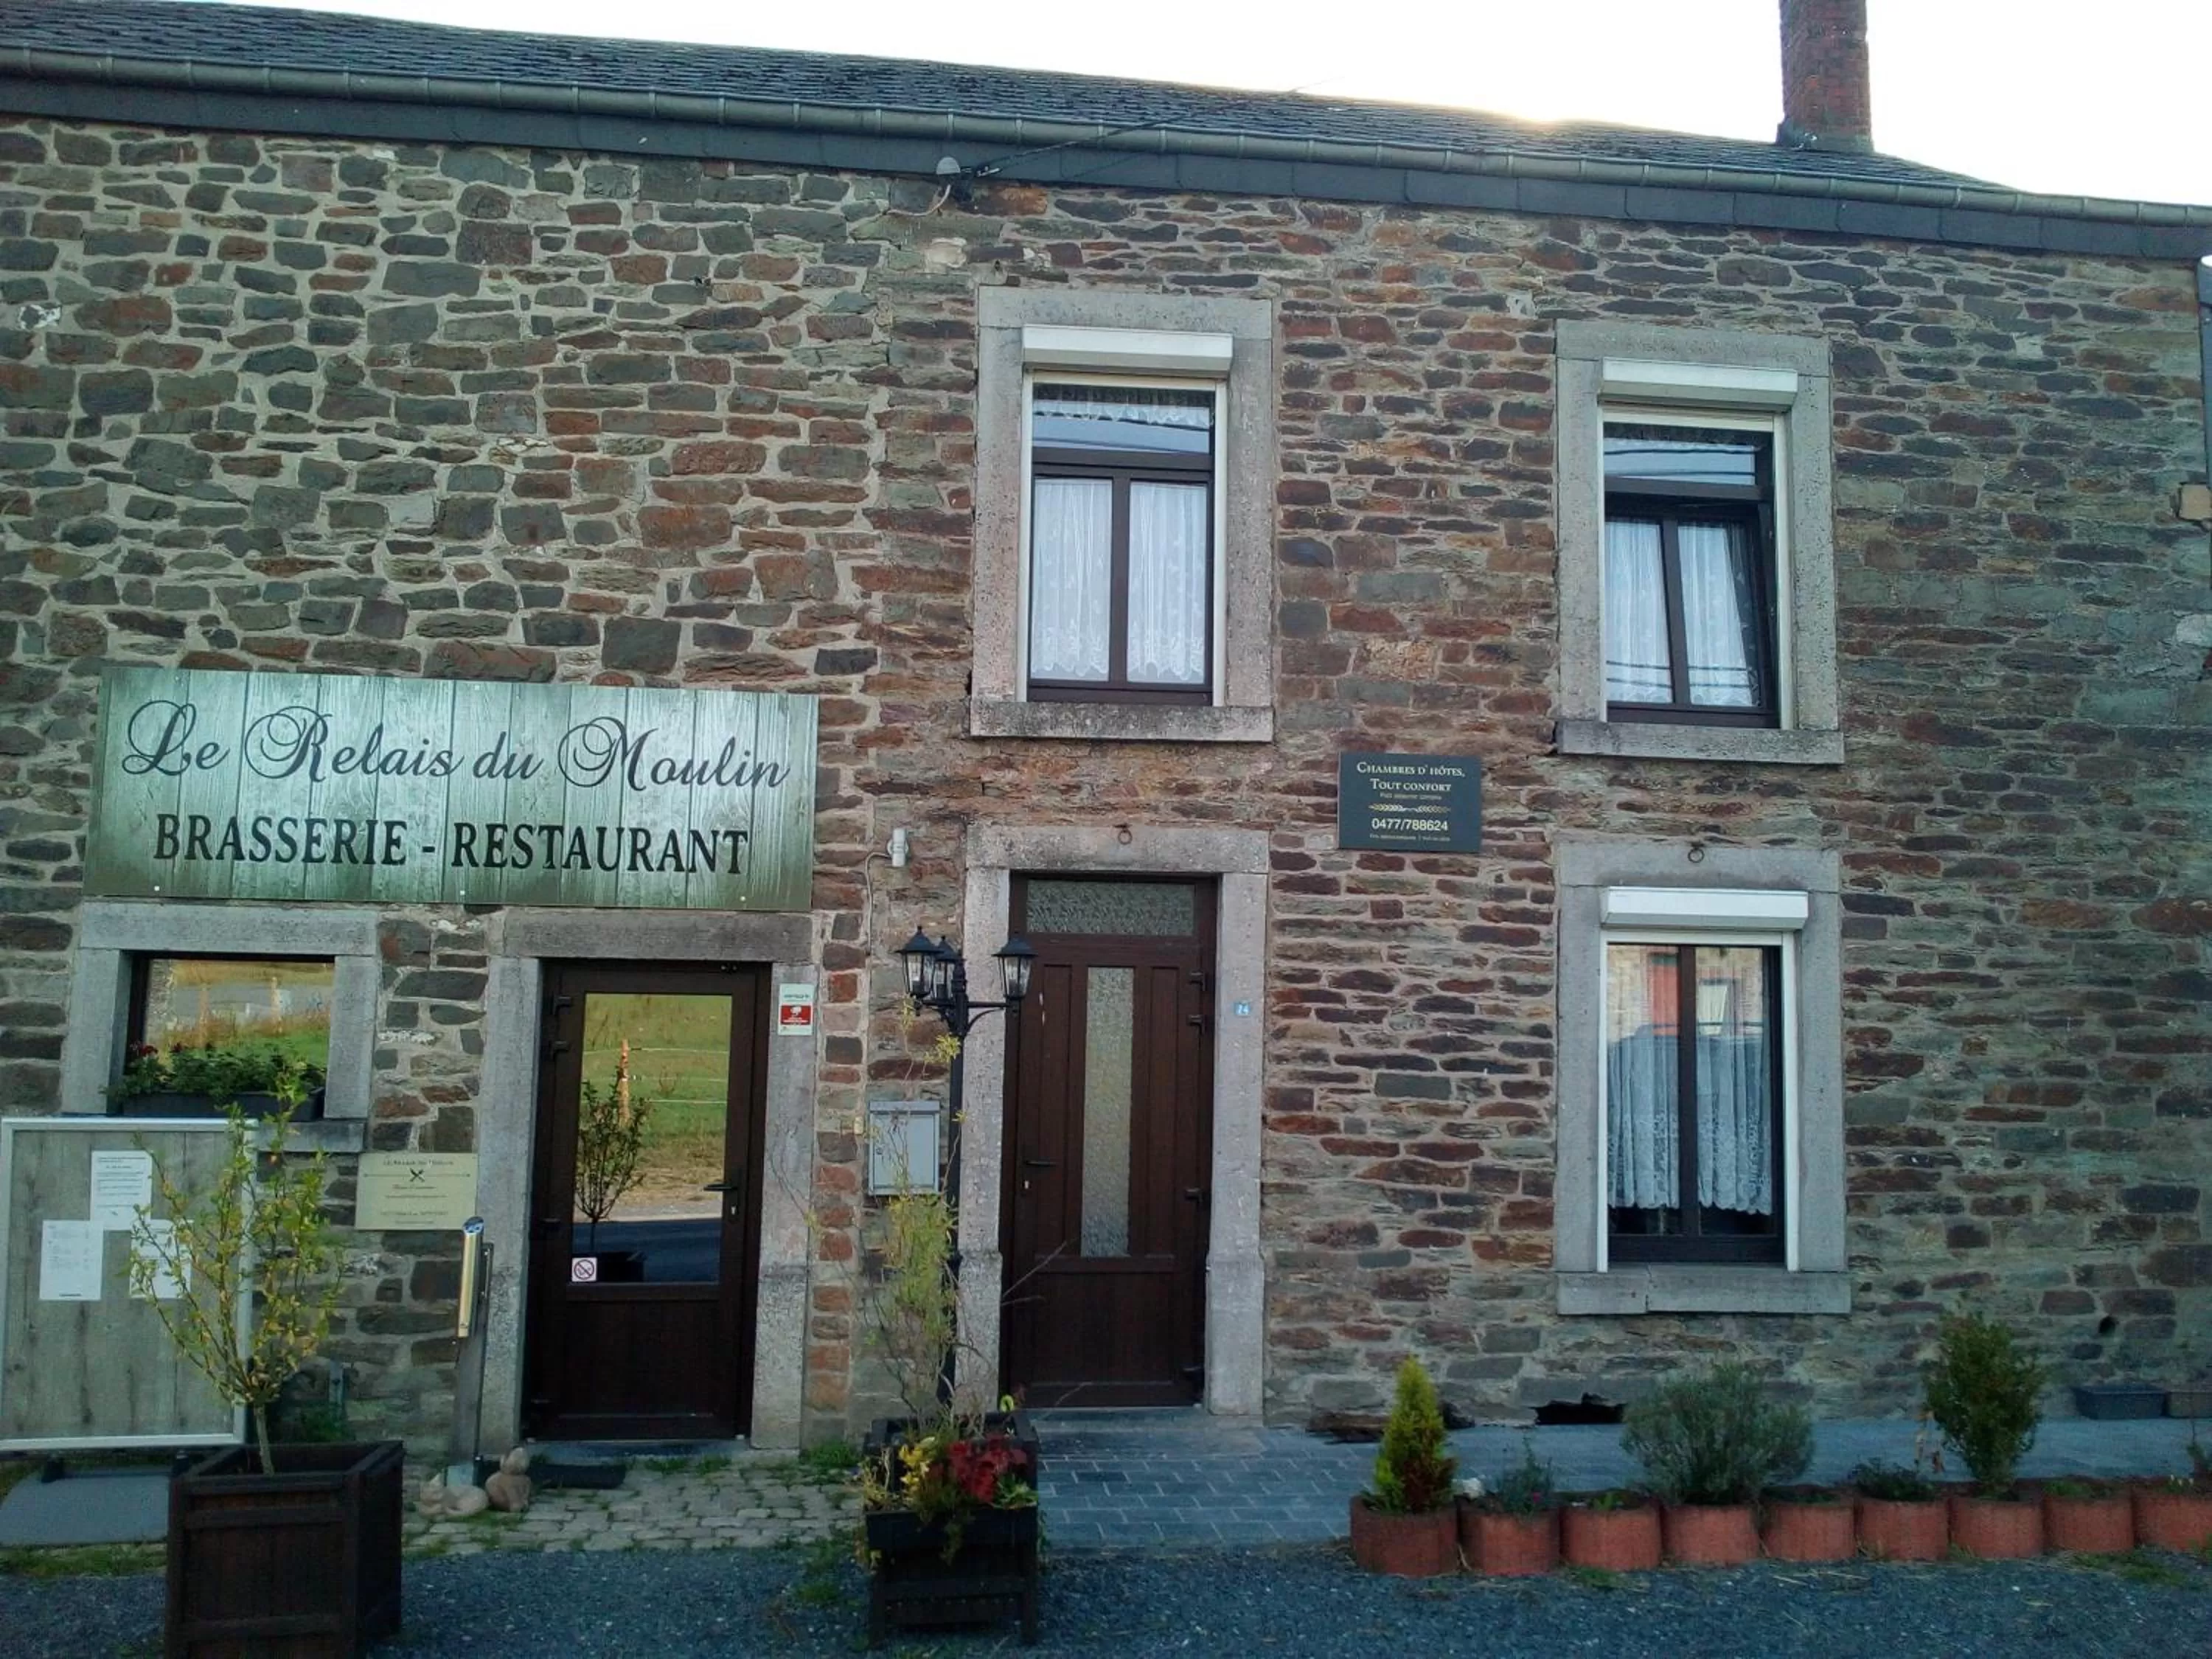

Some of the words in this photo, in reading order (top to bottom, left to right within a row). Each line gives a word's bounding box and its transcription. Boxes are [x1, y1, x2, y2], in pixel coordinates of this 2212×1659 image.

[122, 699, 230, 776] Le
[244, 705, 465, 782] Relais
[472, 731, 545, 780] du
[557, 716, 792, 792] Moulin
[153, 813, 408, 866] BRASSERIE
[451, 821, 749, 874] RESTAURANT
[1371, 817, 1449, 832] 0477/788624
